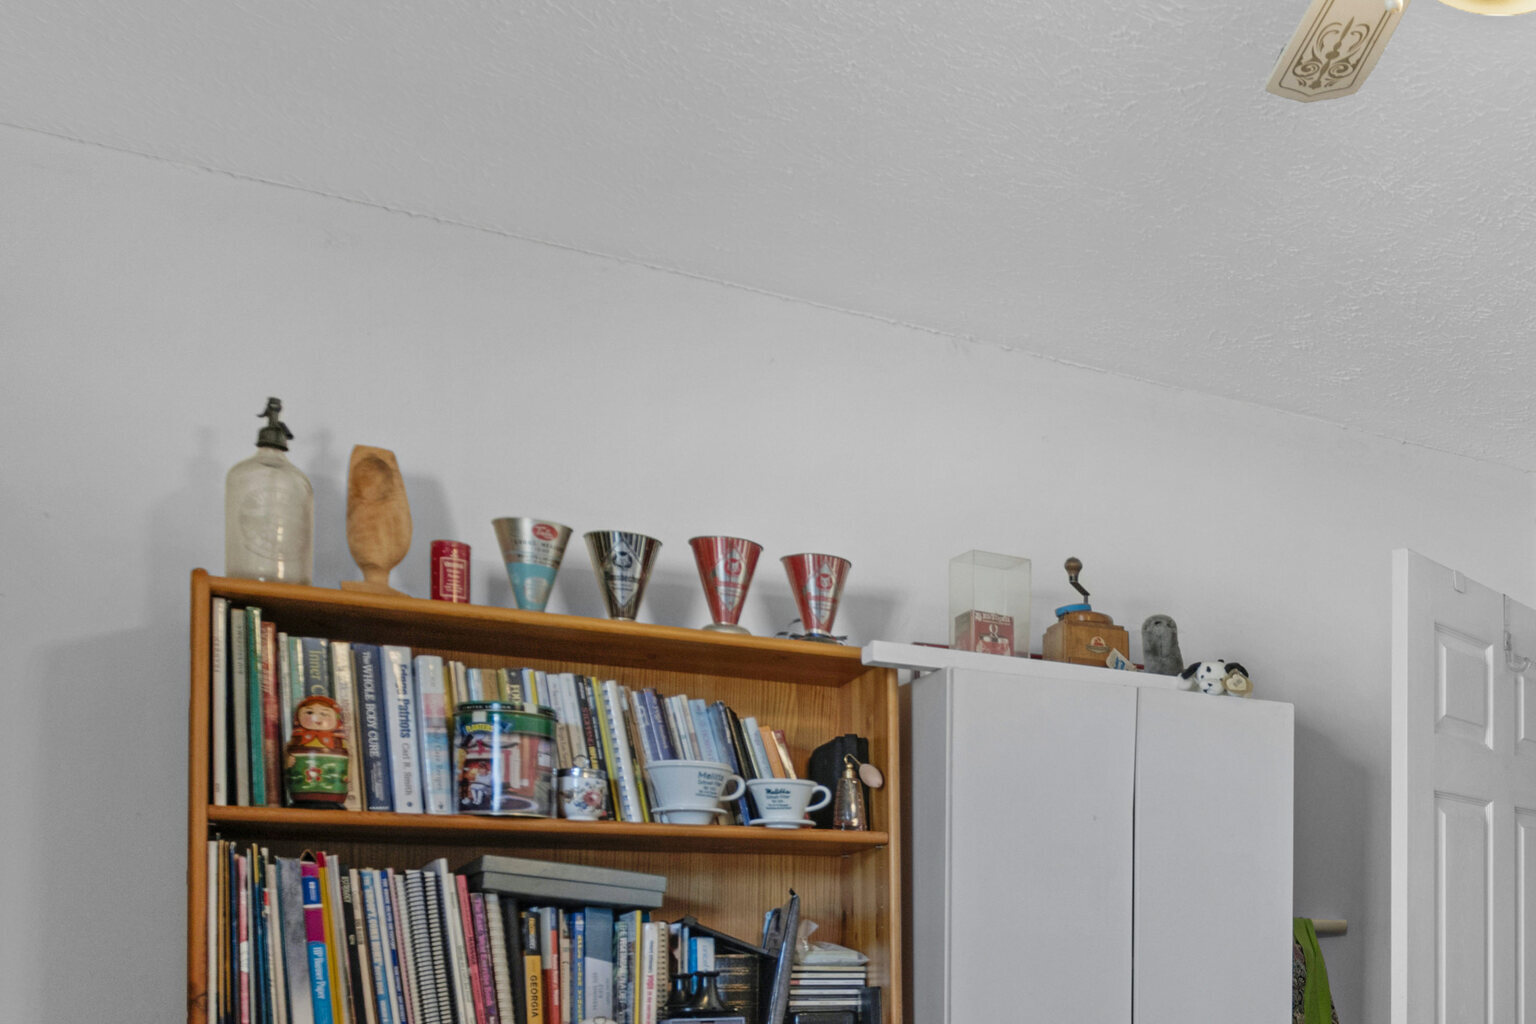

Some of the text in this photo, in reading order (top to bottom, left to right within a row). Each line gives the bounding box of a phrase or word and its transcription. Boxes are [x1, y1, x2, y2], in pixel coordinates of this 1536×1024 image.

[363, 664, 375, 700] WHOLE
[365, 703, 378, 729] BODY
[398, 699, 411, 738] Patriots
[367, 730, 380, 757] CURE
[530, 975, 539, 1018] GEORGIA
